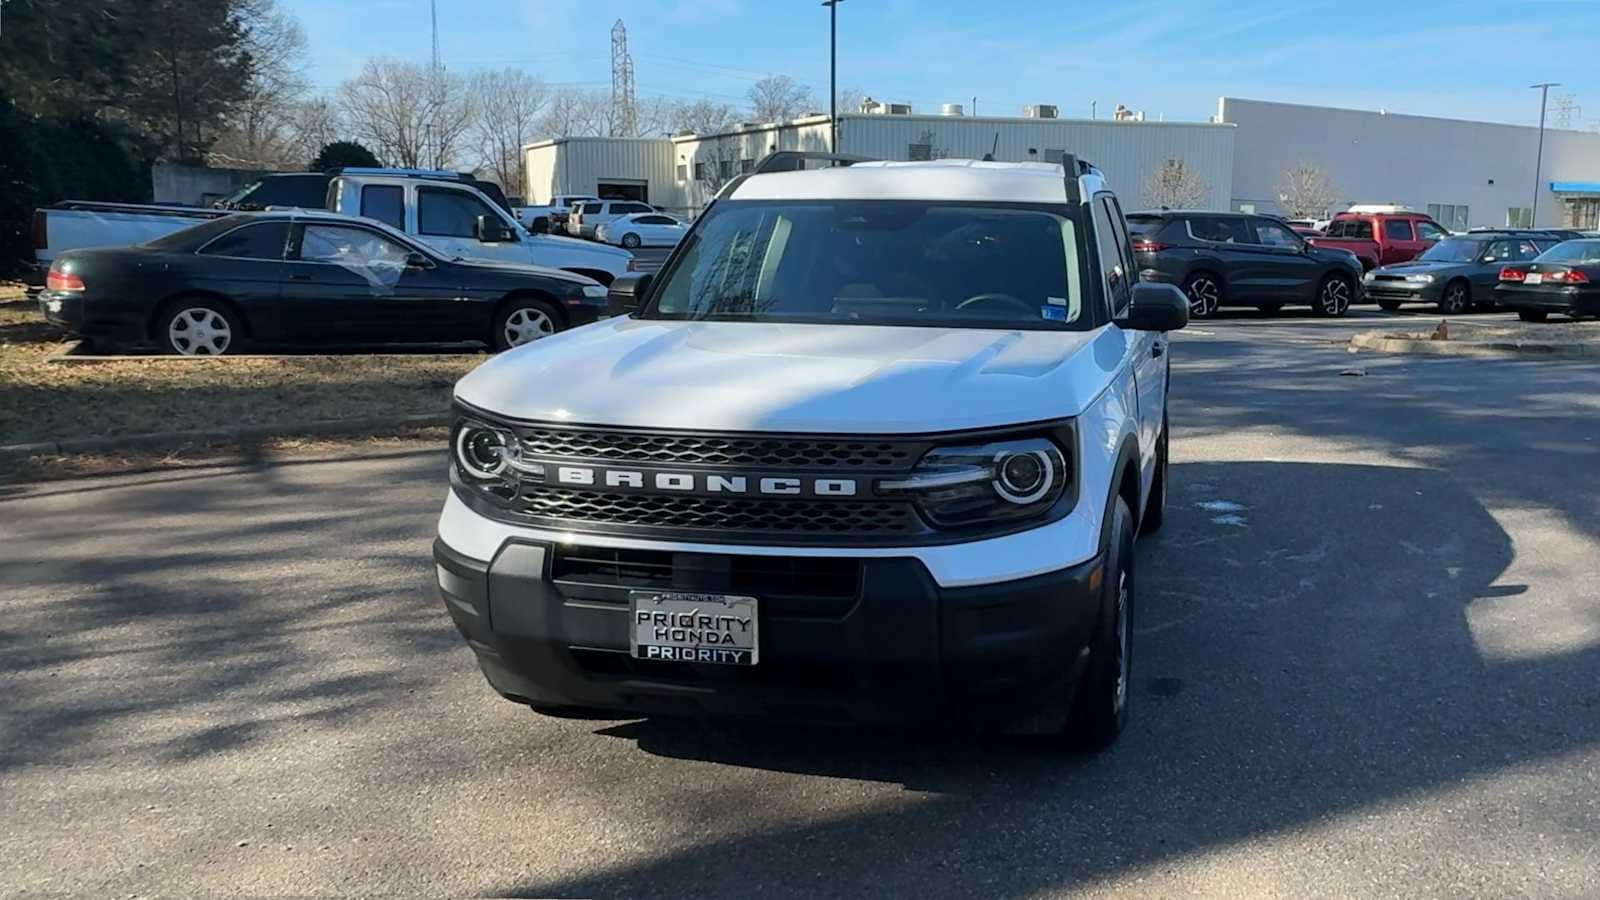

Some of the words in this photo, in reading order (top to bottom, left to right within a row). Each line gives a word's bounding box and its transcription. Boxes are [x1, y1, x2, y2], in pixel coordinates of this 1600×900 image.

[558, 466, 857, 497] BRONCO
[636, 610, 751, 632] PRIORITY
[654, 627, 736, 645] HONDA
[647, 646, 743, 664] PRIORITY
